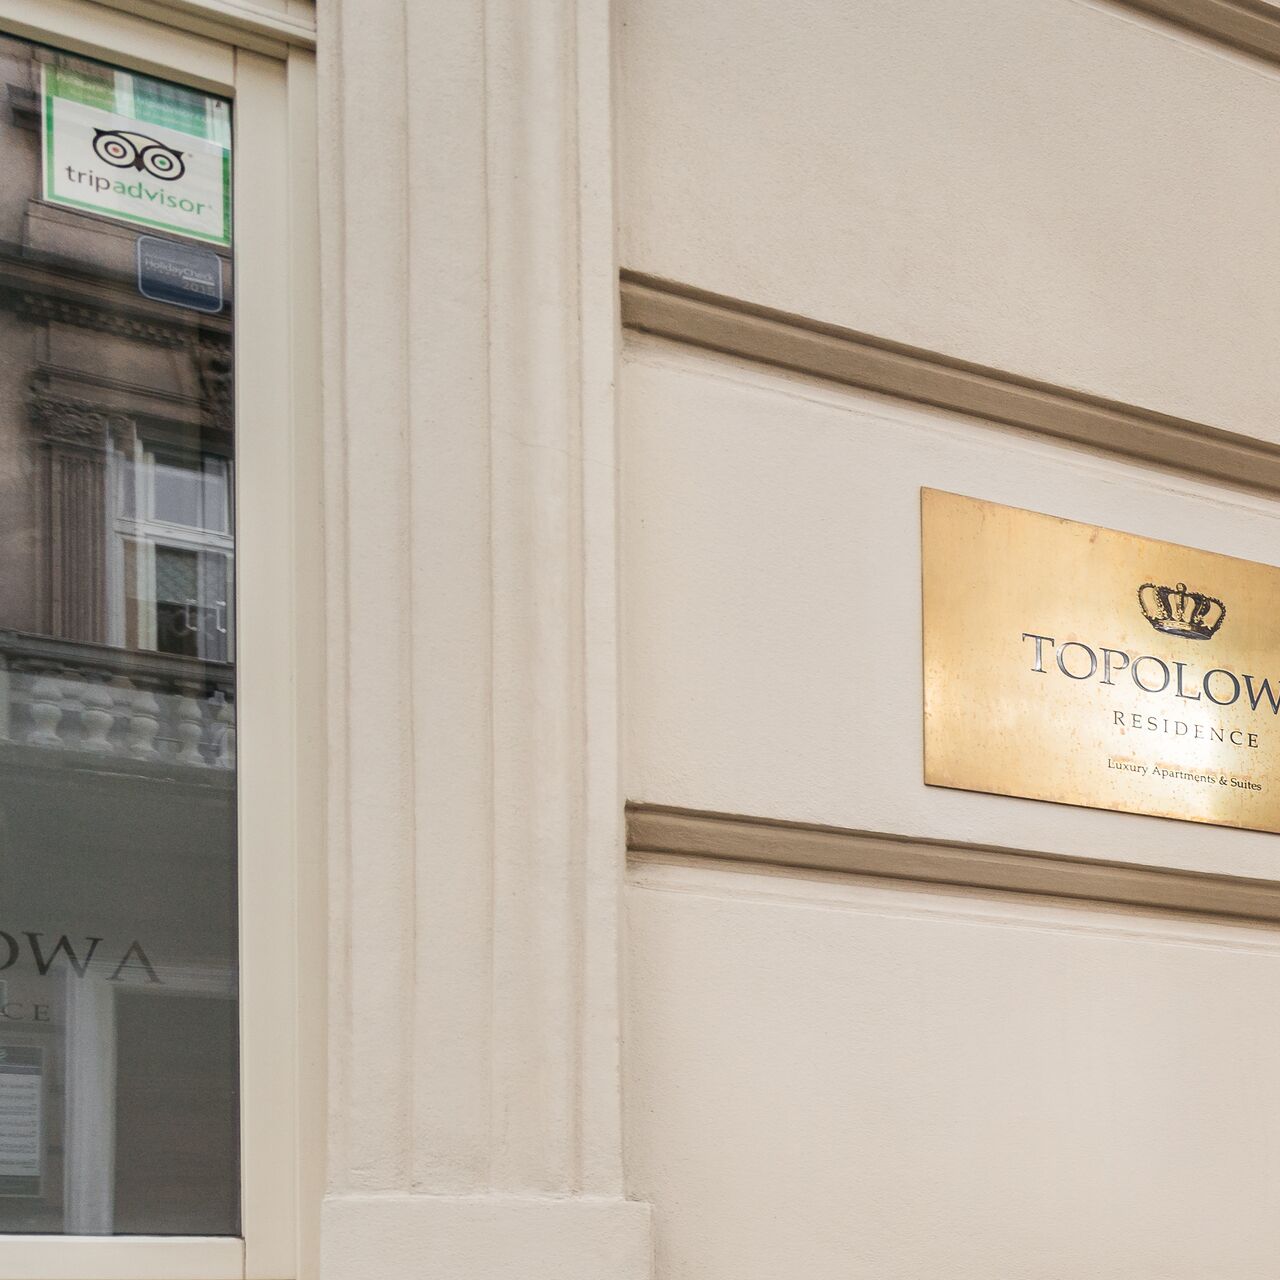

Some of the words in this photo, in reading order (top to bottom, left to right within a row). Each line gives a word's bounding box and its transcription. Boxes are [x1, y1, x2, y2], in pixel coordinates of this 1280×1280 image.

[65, 165, 206, 215] tripadvisor
[1113, 710, 1259, 748] RESIDENCE
[1107, 758, 1148, 776] Luxury
[1152, 766, 1216, 784] Apartments
[1218, 776, 1228, 786] &
[1230, 777, 1262, 791] Suites
[0, 930, 166, 984] WA
